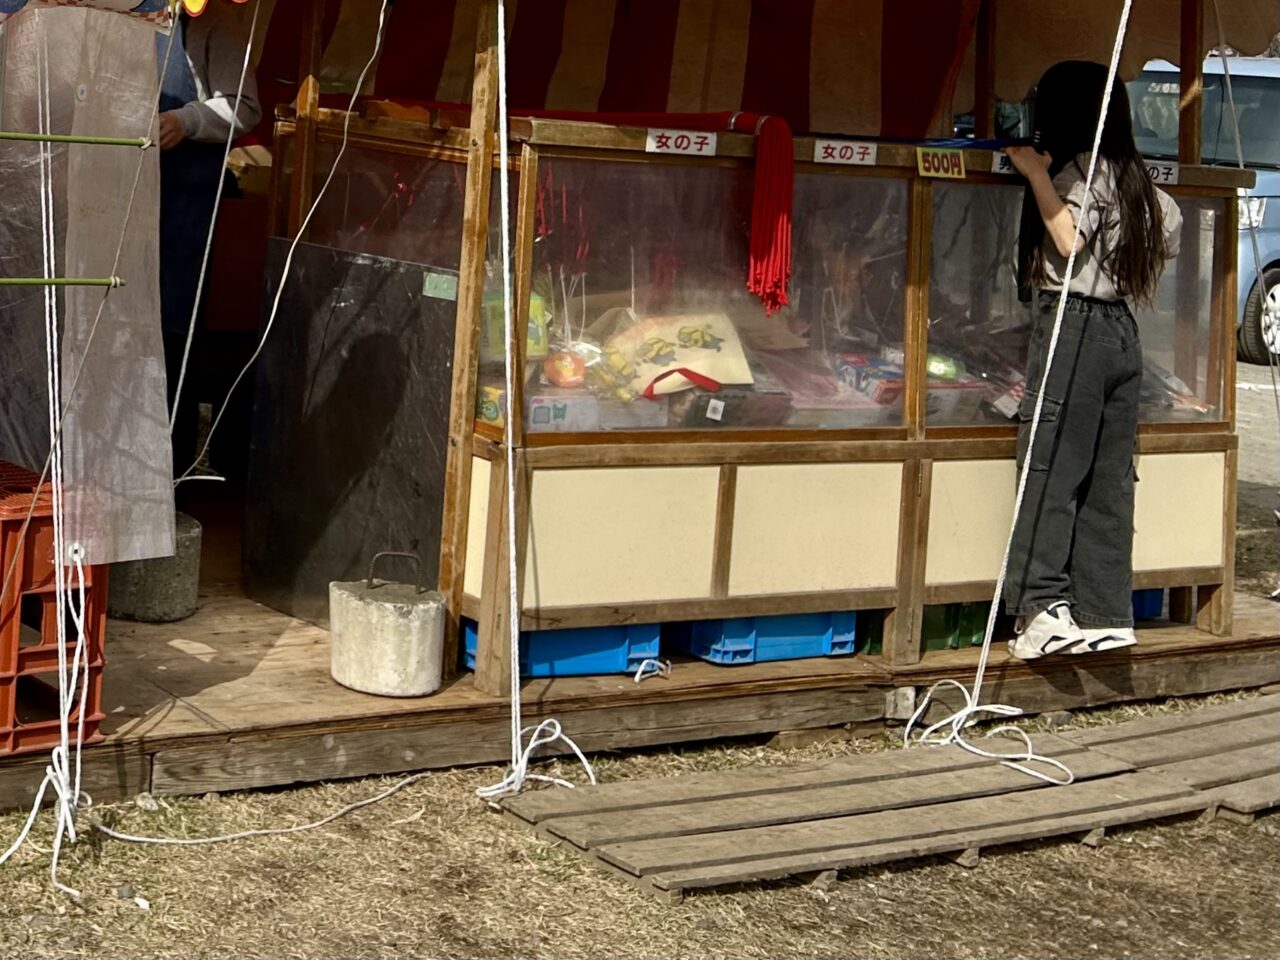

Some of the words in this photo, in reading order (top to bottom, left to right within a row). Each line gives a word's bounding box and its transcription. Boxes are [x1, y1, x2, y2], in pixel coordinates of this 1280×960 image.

[655, 133, 710, 152] 女の子
[821, 143, 871, 161] 女の子
[921, 151, 963, 176] 500円
